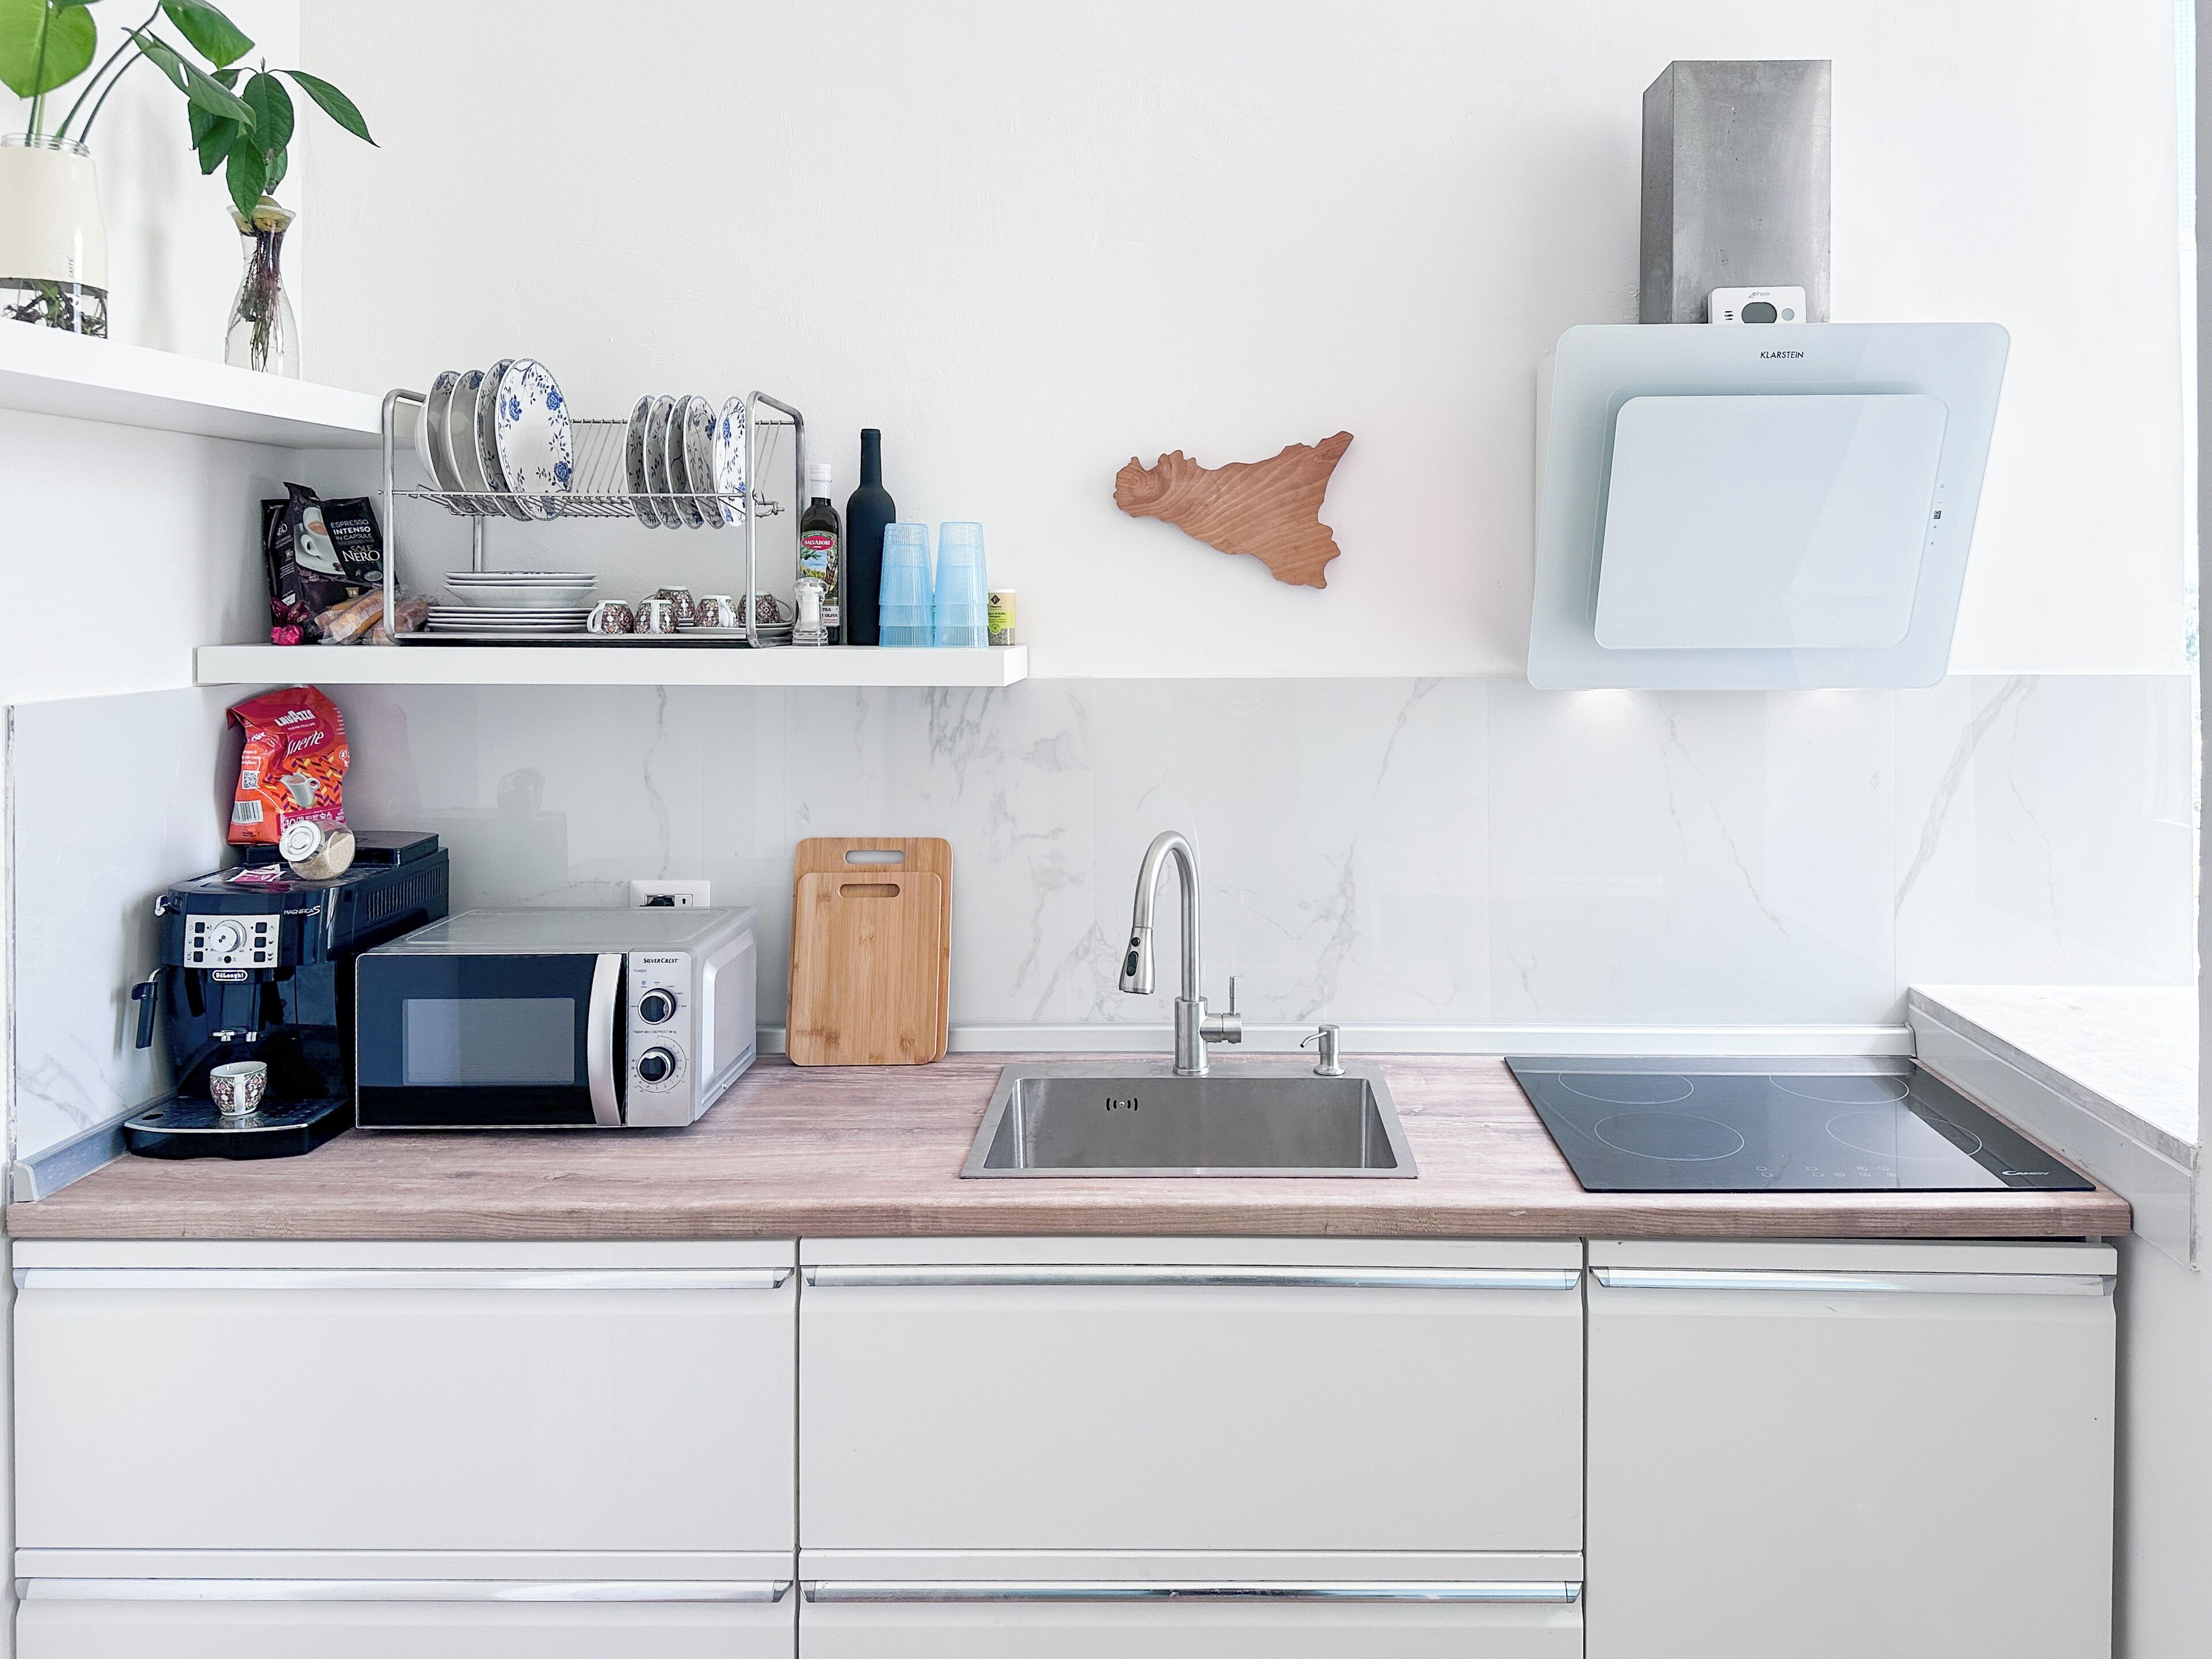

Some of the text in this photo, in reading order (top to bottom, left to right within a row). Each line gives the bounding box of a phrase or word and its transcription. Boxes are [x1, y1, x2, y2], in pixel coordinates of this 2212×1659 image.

[1760, 351, 1804, 359] KLARSTEIN
[331, 519, 369, 528] ESPRESSO
[334, 526, 371, 535] INTENSO
[342, 550, 380, 562] NERO
[274, 710, 316, 726] LAVAZZA
